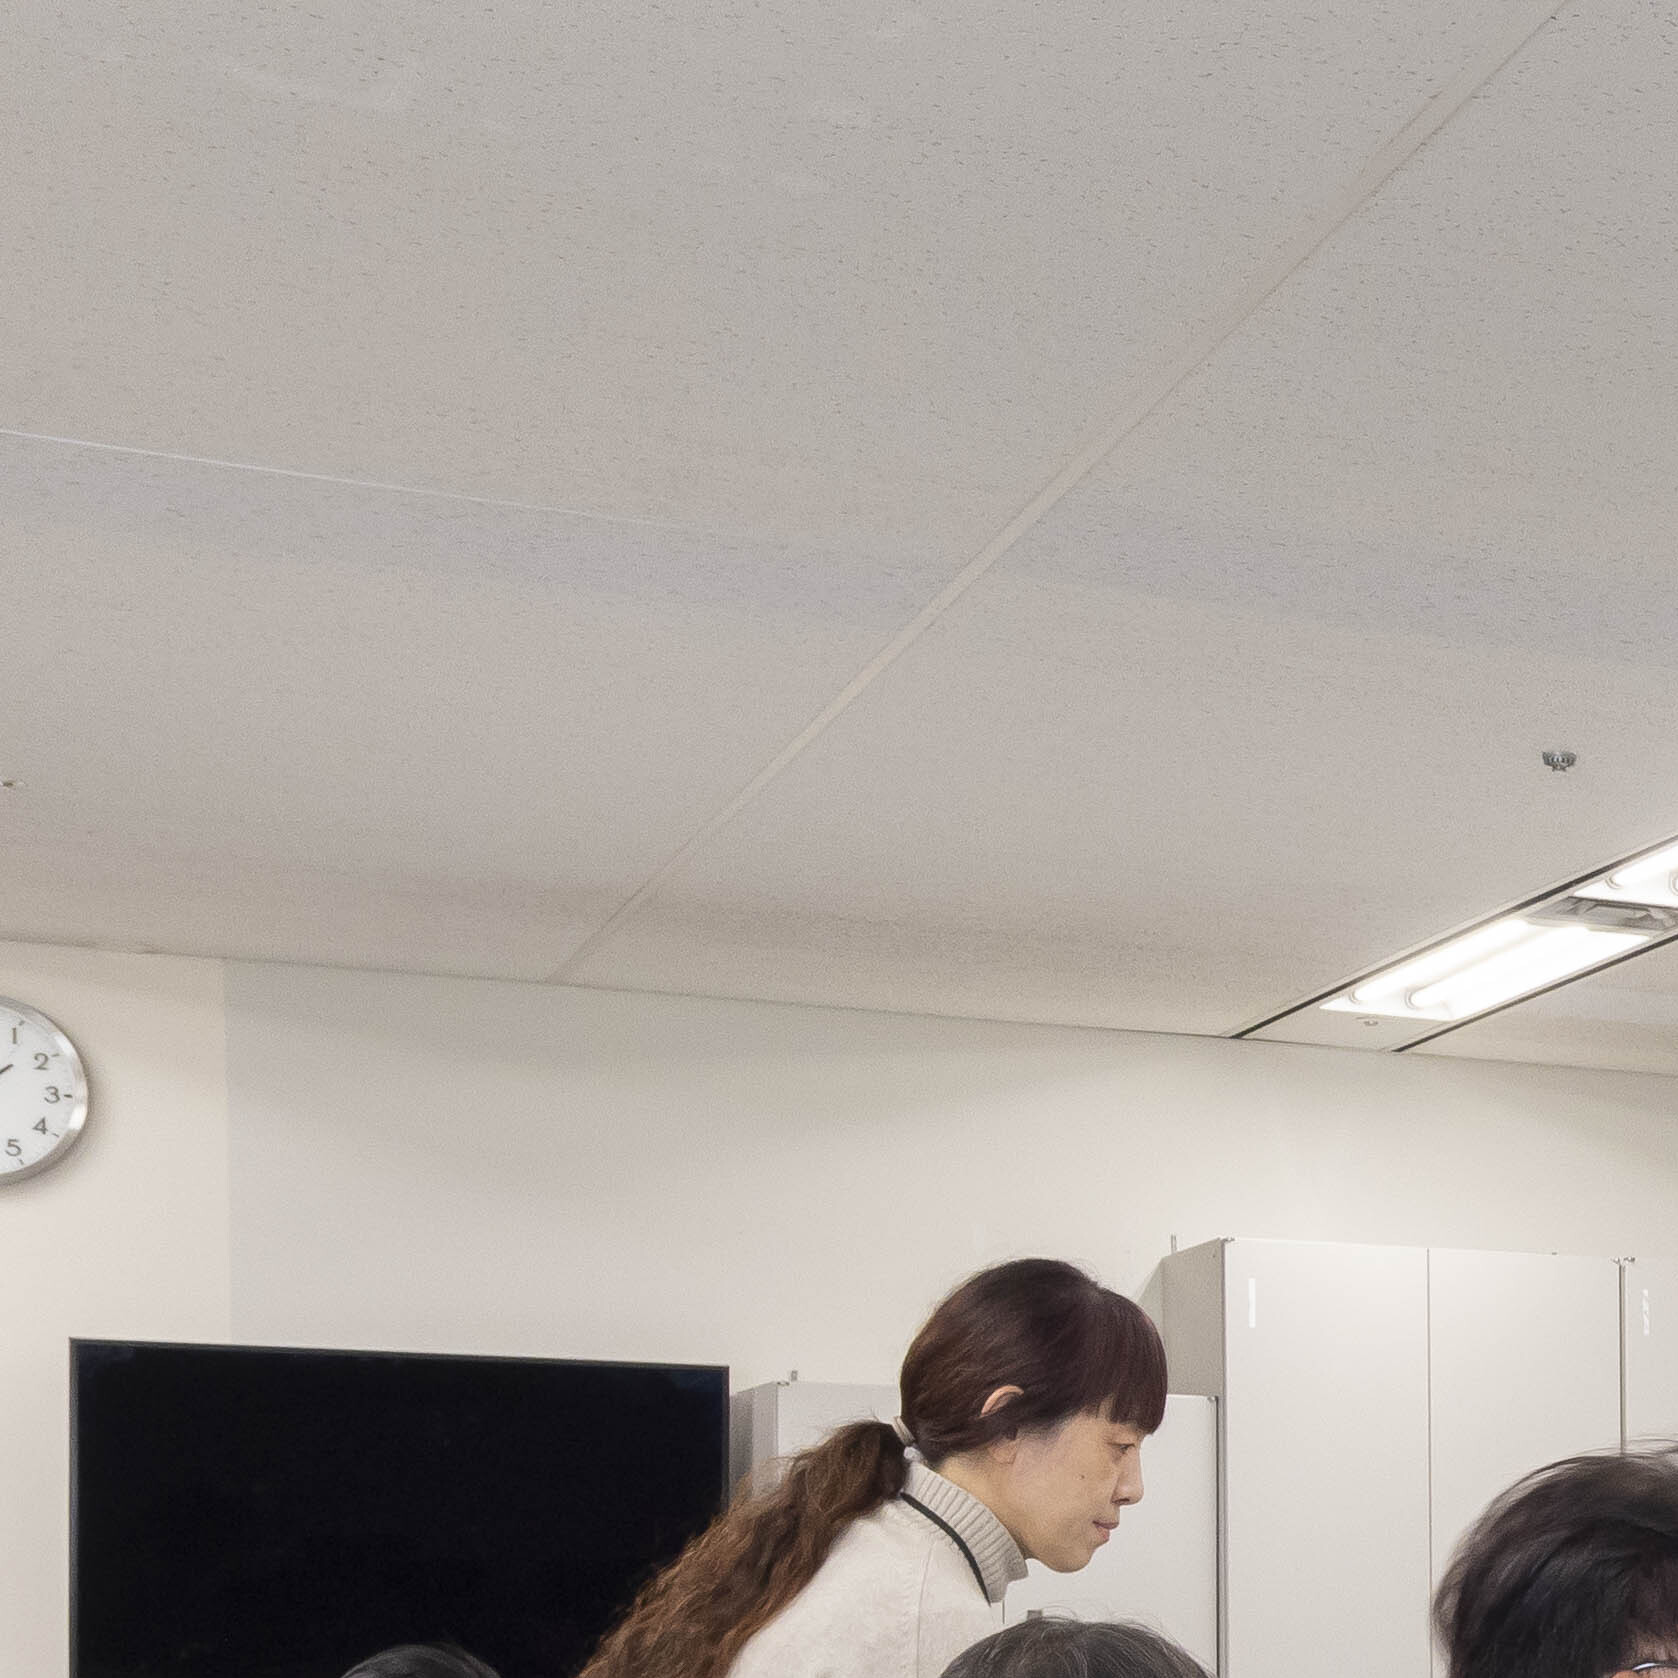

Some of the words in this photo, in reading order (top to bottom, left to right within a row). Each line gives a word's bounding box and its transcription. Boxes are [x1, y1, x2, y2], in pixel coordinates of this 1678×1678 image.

[12, 1027, 18, 1044] 1
[34, 1052, 49, 1070] 2
[44, 1086, 60, 1104] 3
[32, 1117, 48, 1135] 4
[5, 1139, 22, 1157] 5
